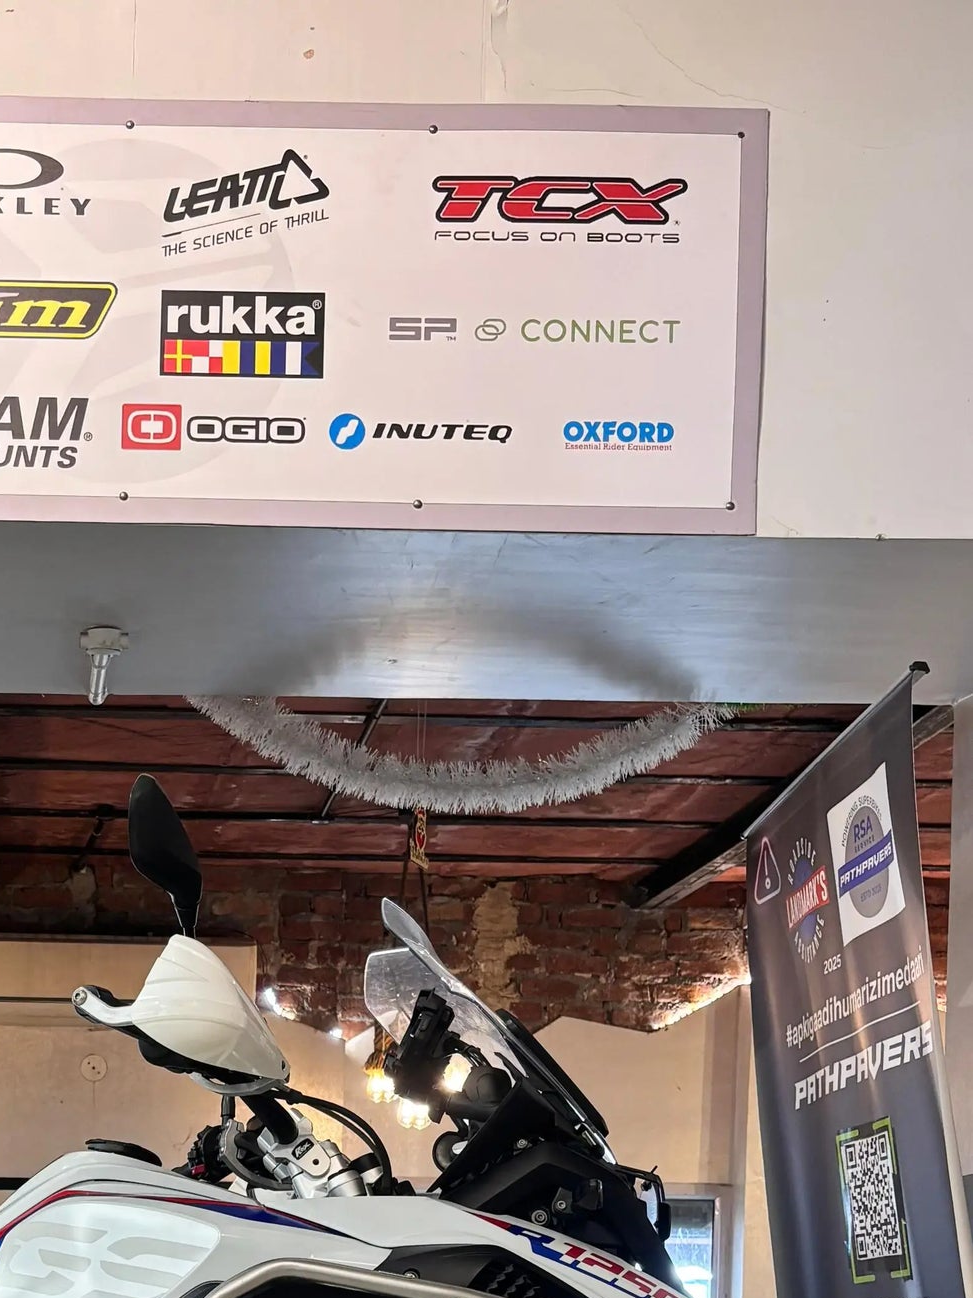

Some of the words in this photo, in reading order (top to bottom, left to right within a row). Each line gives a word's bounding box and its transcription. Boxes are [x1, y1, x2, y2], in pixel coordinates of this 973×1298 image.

[432, 175, 688, 225] TCX
[161, 240, 187, 257] THE
[193, 225, 253, 251] SCIENCE
[259, 219, 278, 235] OF
[284, 208, 329, 230] THRILL
[434, 230, 530, 242] FOCUS
[587, 232, 680, 244] BOOTS
[166, 295, 316, 336] rukka
[388, 317, 458, 341] SP
[520, 318, 681, 344] CONNECT
[186, 416, 306, 445] OGIO
[372, 422, 513, 445] INUTEQ
[563, 420, 675, 443] OXFORD
[564, 442, 601, 450] Essential
[603, 443, 625, 451] Rider
[627, 443, 672, 451] Equipment
[853, 815, 873, 843] RSA
[840, 842, 892, 889] PATHPAVERS
[786, 869, 828, 930] LANDMARK'S
[823, 954, 842, 974] 2025
[786, 945, 925, 1049] #apkigaadihumarizimedaari
[794, 1020, 933, 1110] PATHPAVERS
